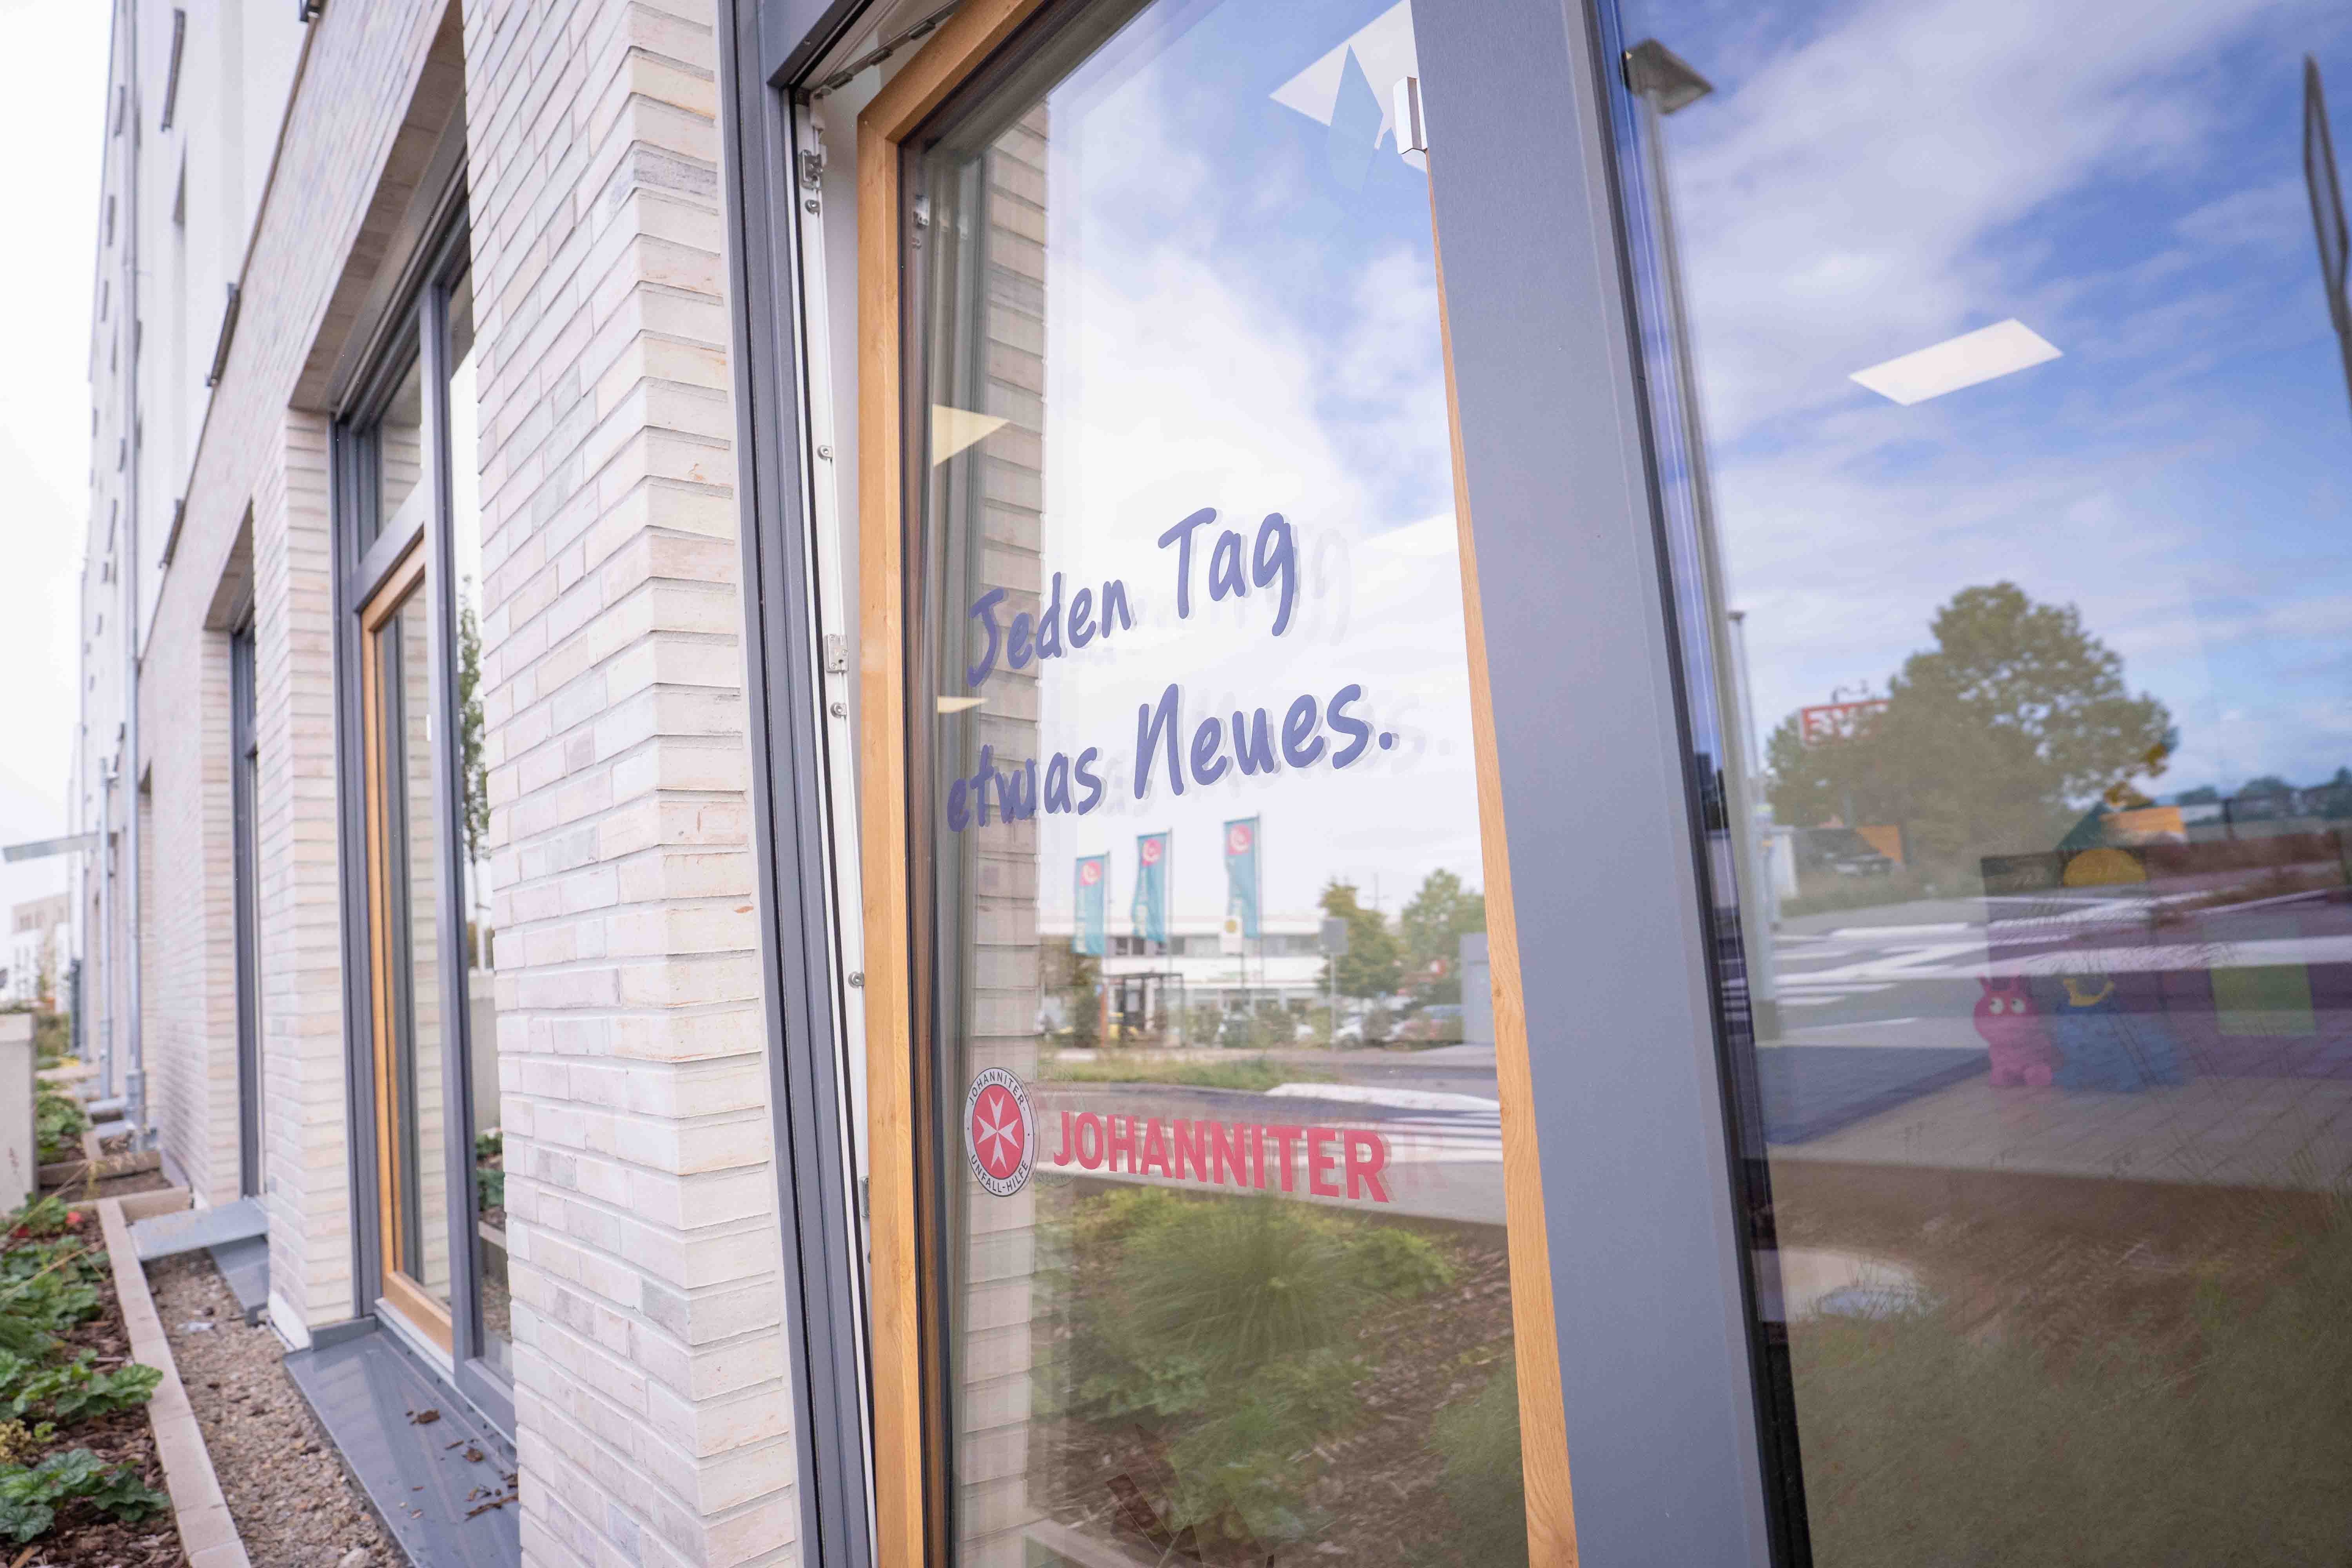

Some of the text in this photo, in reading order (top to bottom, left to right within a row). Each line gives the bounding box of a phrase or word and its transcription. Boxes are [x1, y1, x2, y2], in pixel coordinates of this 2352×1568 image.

[967, 507, 1294, 687] Jeden Tag
[947, 683, 1393, 832] etwas Neues.
[969, 1071, 1026, 1112] JOHANNITER-
[971, 1154, 1028, 1193] UNFALL-HILFE
[1053, 1111, 1390, 1203] JOHANNITER
